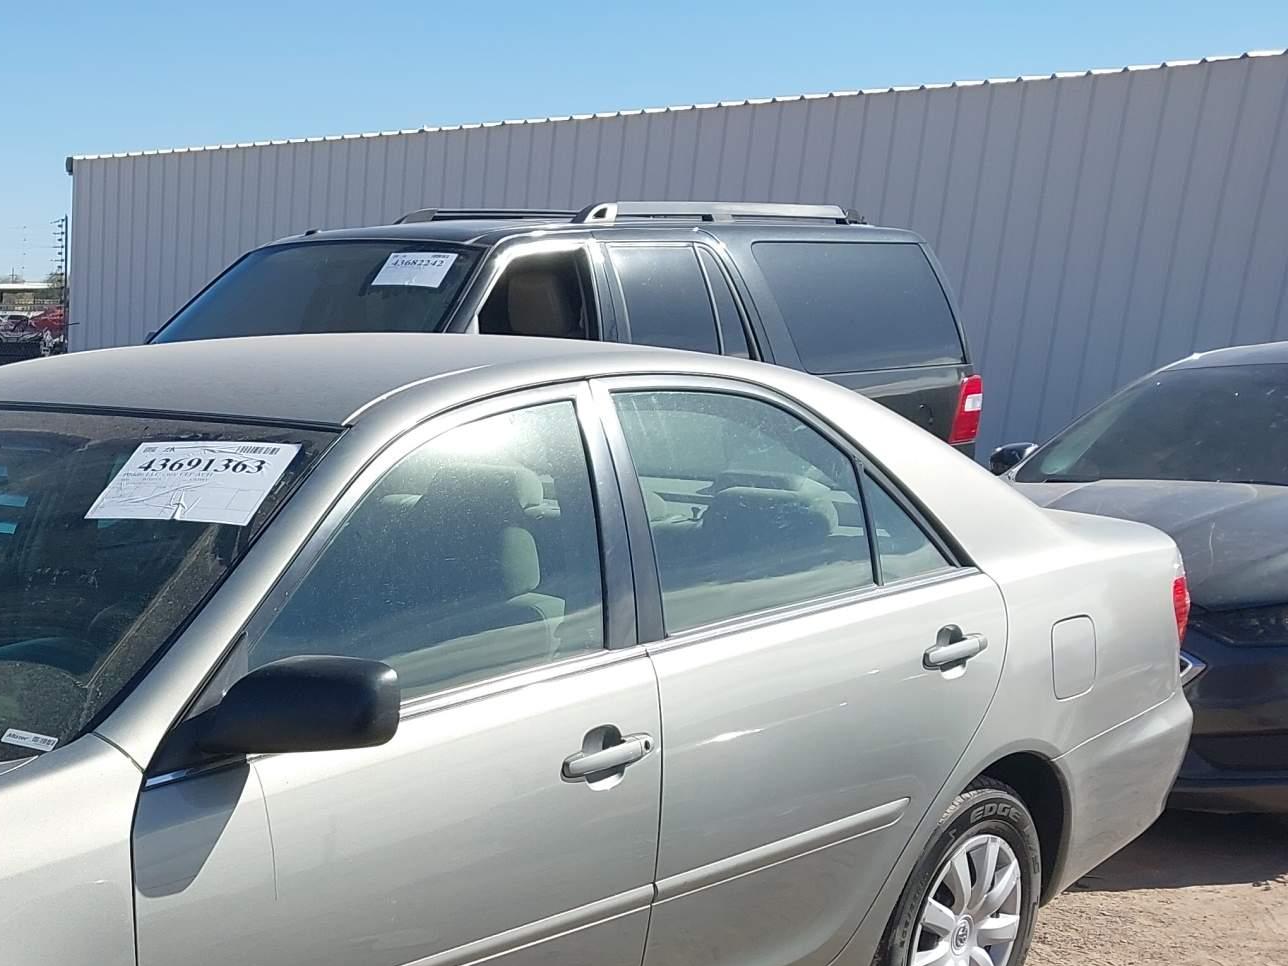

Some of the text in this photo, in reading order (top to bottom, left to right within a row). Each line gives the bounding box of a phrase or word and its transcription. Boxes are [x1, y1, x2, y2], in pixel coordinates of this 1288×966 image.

[392, 258, 444, 267] 43682242
[137, 457, 267, 474] 43691363
[970, 803, 1023, 824] EDGE
